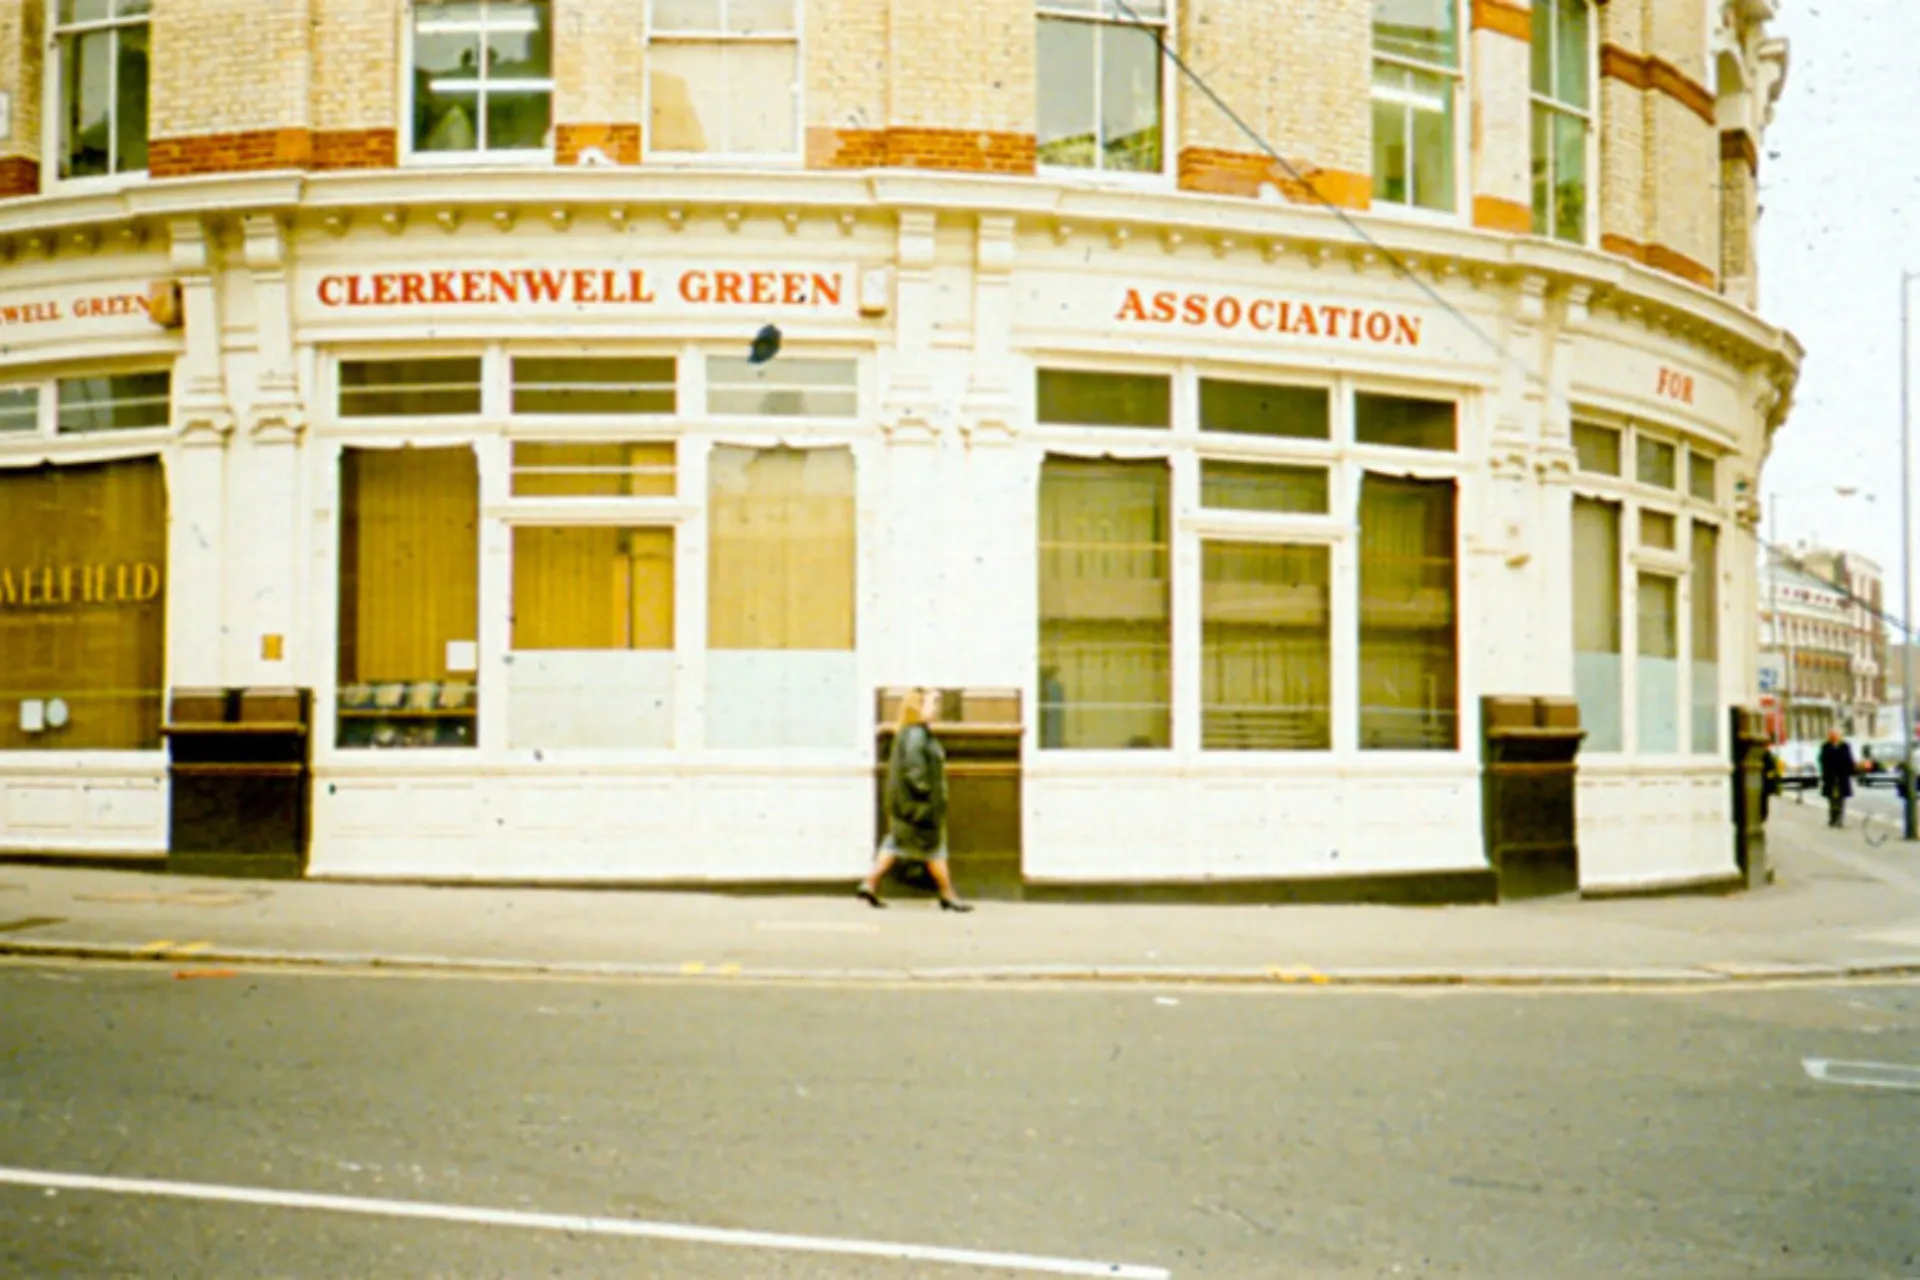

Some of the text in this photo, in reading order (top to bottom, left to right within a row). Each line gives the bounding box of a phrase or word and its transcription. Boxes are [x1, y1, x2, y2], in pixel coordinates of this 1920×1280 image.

[316, 268, 841, 306] CLERKENWELL GREEN
[0, 301, 63, 324] WELL
[1115, 288, 1419, 346] ASSOCIATION
[1657, 367, 1694, 404] FOR
